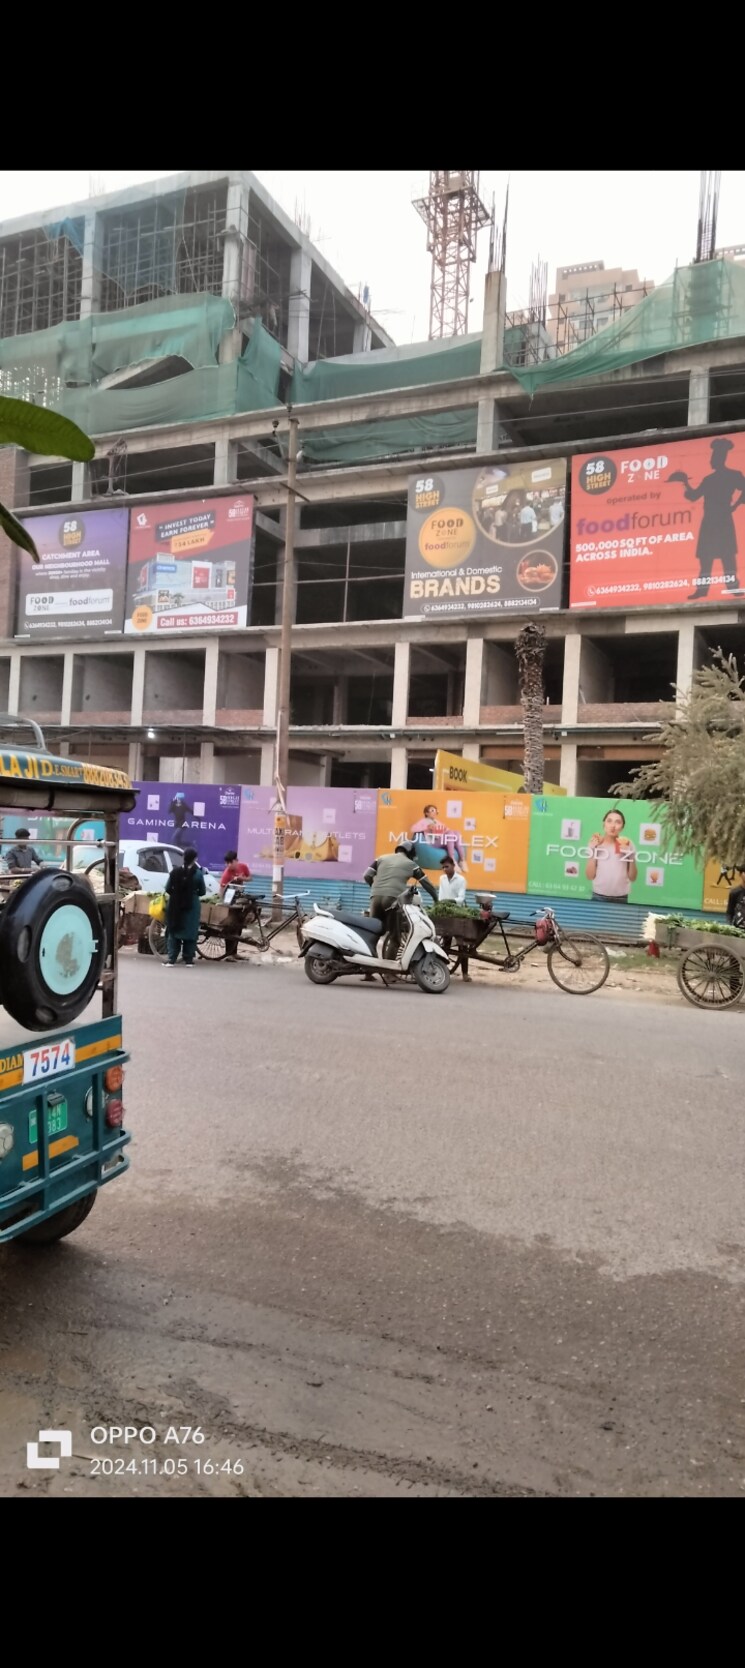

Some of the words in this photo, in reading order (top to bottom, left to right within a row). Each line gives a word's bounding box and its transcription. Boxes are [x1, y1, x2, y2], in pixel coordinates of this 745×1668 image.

[586, 460, 605, 476] 58
[620, 455, 669, 474] FOOD
[415, 478, 434, 493] 58
[586, 472, 611, 485] HIGH
[586, 481, 611, 491] STREET
[415, 489, 440, 502] HIGH
[606, 493, 648, 505] operated
[650, 491, 661, 500] by
[415, 500, 440, 509] STREET
[64, 520, 77, 532] 58
[165, 519, 187, 530] INVEST
[189, 513, 211, 524] TODAY
[431, 518, 463, 530] FOOD
[576, 509, 692, 536] foodforum
[161, 528, 178, 538] EARN
[180, 522, 209, 536] FOREVER
[575, 540, 619, 553] 500,000
[620, 538, 634, 548] SQ
[635, 536, 647, 546] FT
[649, 535, 663, 545] OF
[664, 532, 694, 543] AREA
[42, 551, 80, 560] CATCHMENT
[82, 550, 100, 558] AREA
[576, 550, 617, 563] ACROSS
[620, 547, 653, 558] INDIA.
[411, 568, 457, 580] International
[466, 565, 503, 575] Domestic
[410, 575, 501, 599] BRANDS
[30, 596, 54, 605] FOOD
[160, 617, 175, 627] Call
[176, 617, 188, 625] us:
[189, 614, 235, 625] 6364934232
[449, 766, 467, 783] BOOK
[128, 817, 175, 827] GAMING
[181, 821, 226, 831] ARENA
[388, 831, 499, 848] MULTIPLEX
[546, 844, 610, 861] FOOD
[619, 849, 684, 866] ZONE
[31, 1042, 71, 1076] 7574
